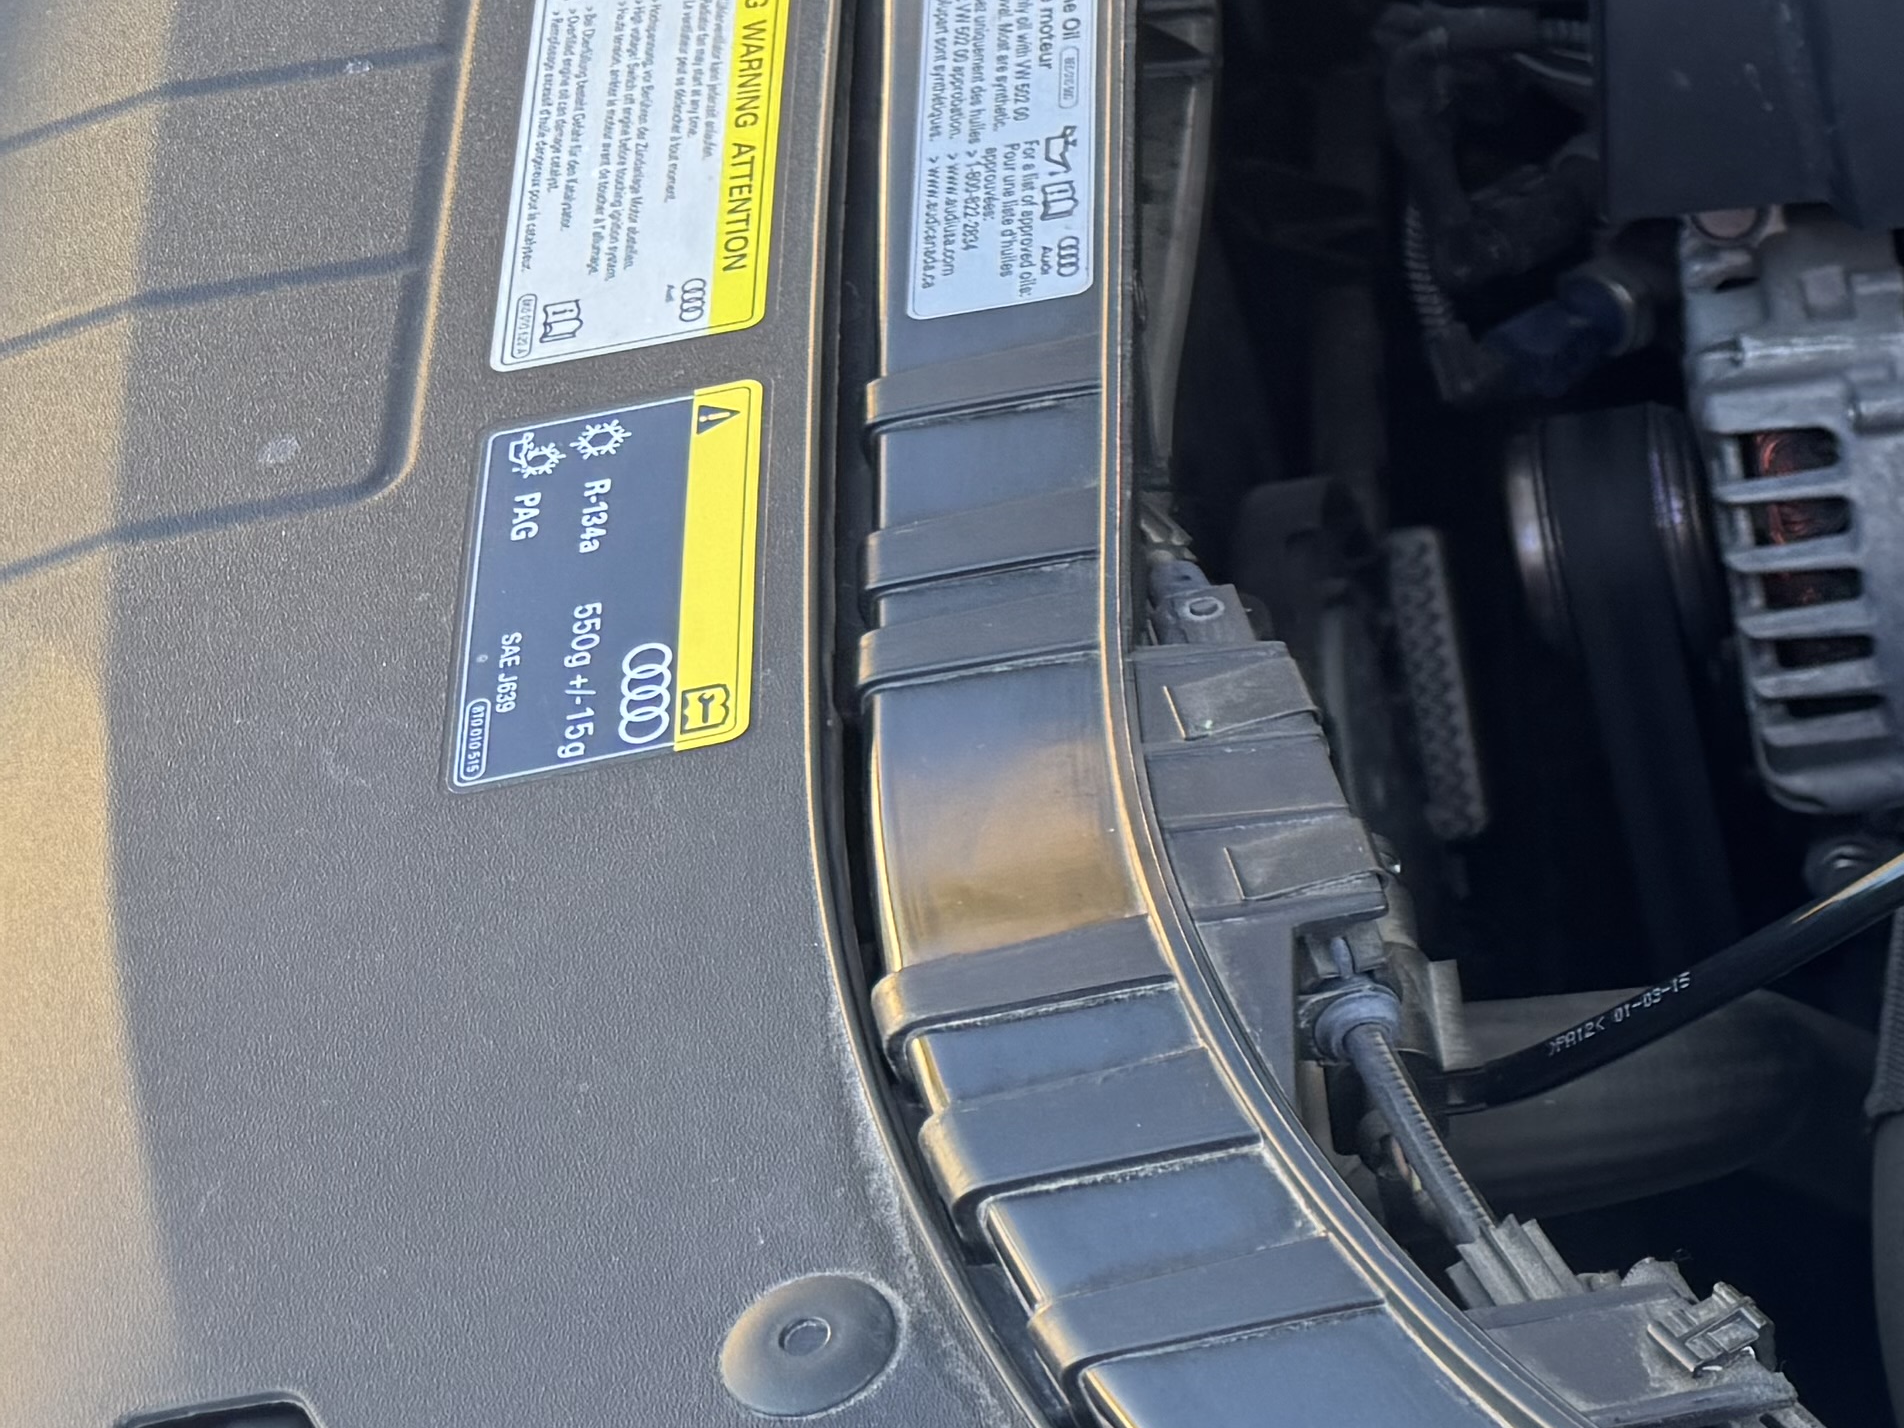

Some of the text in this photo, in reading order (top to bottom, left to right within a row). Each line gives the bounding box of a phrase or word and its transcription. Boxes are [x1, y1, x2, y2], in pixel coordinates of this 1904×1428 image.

[1015, 14, 1032, 31] oil
[1061, 16, 1080, 41] Oil
[1015, 32, 1032, 58] with
[1037, 6, 1054, 71] moteur
[733, 19, 767, 130] WARNING
[1014, 59, 1030, 81] VW
[1013, 82, 1030, 104] 502
[1012, 105, 1029, 122] 00
[720, 139, 756, 273] ATTENTION
[1016, 138, 1040, 298] For a list of approved oils:
[578, 477, 612, 555] R-134a
[493, 490, 541, 715] PAG SAE J639
[563, 600, 602, 669] 550g
[467, 728, 483, 750] 010
[465, 750, 481, 774] 515
